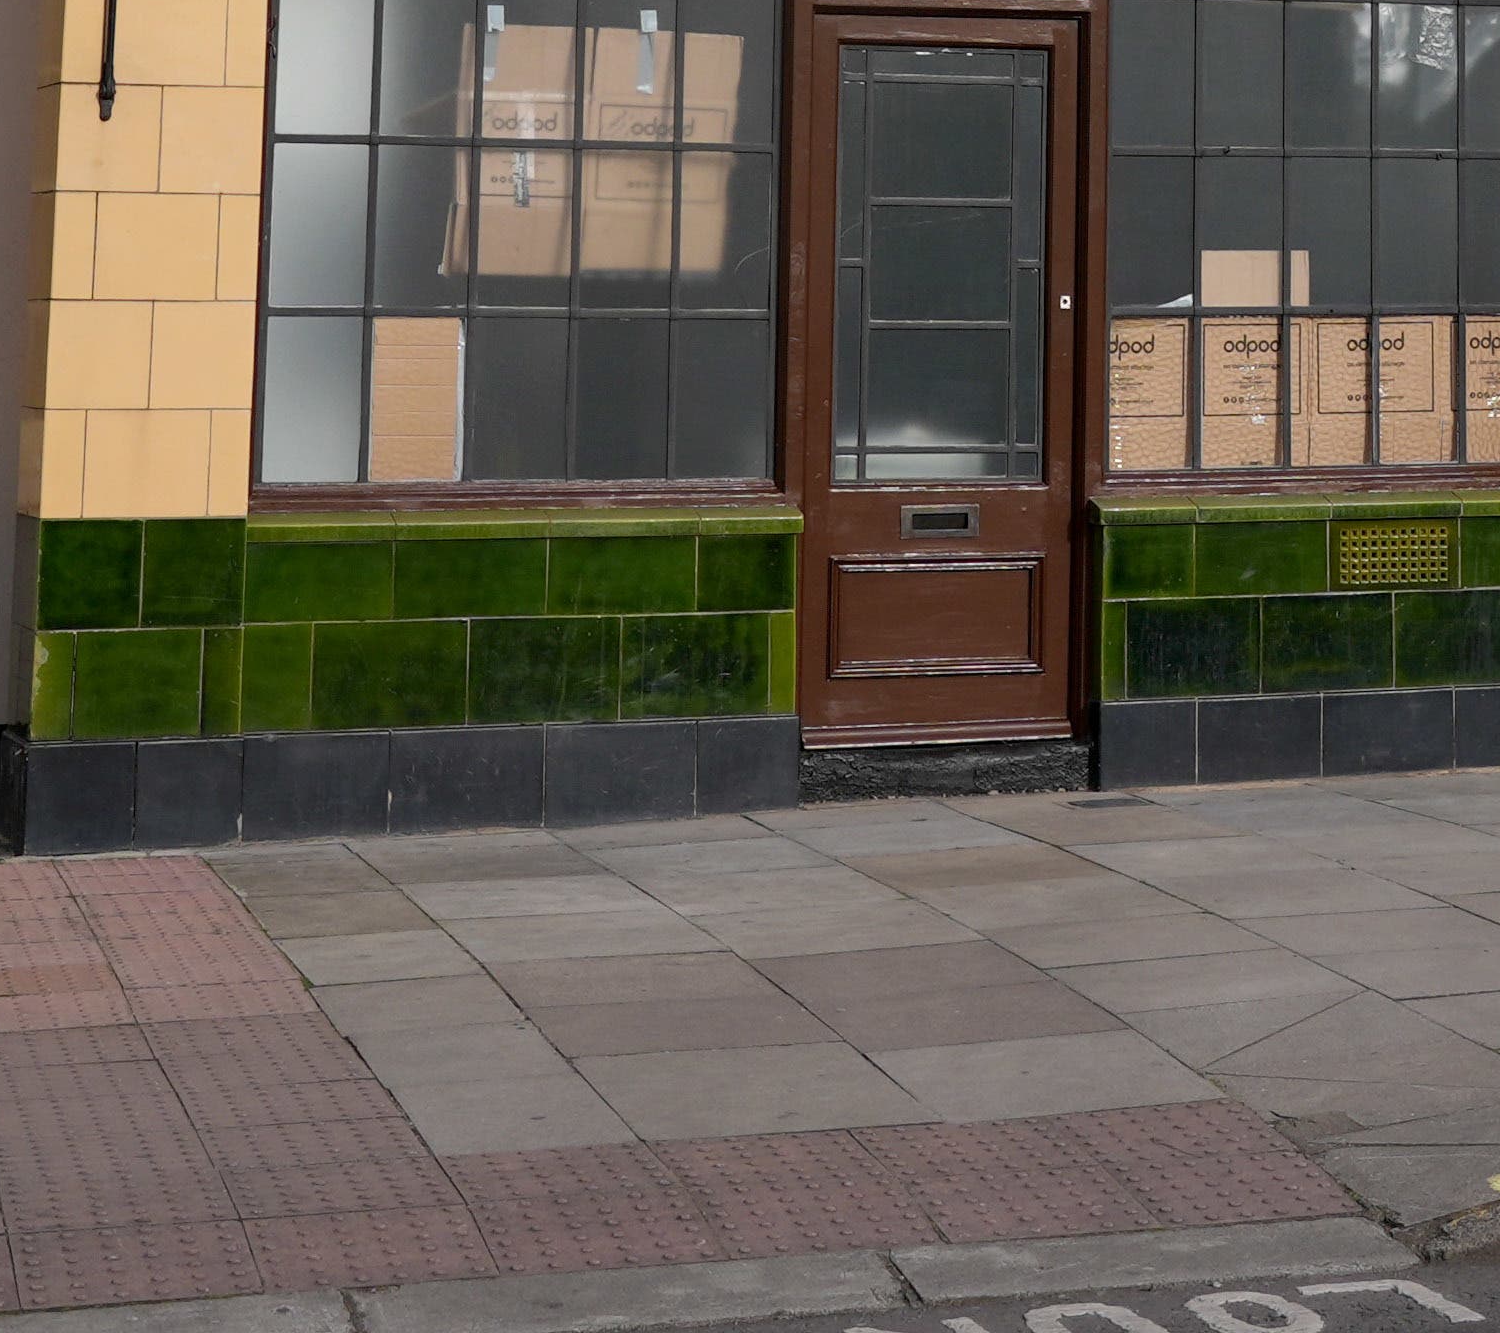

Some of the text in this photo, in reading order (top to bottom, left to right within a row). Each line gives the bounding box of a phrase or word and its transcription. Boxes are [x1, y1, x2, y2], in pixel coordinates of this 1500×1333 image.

[1109, 334, 1155, 361] dpod
[1223, 334, 1281, 359] odpod
[1346, 331, 1405, 352] odod
